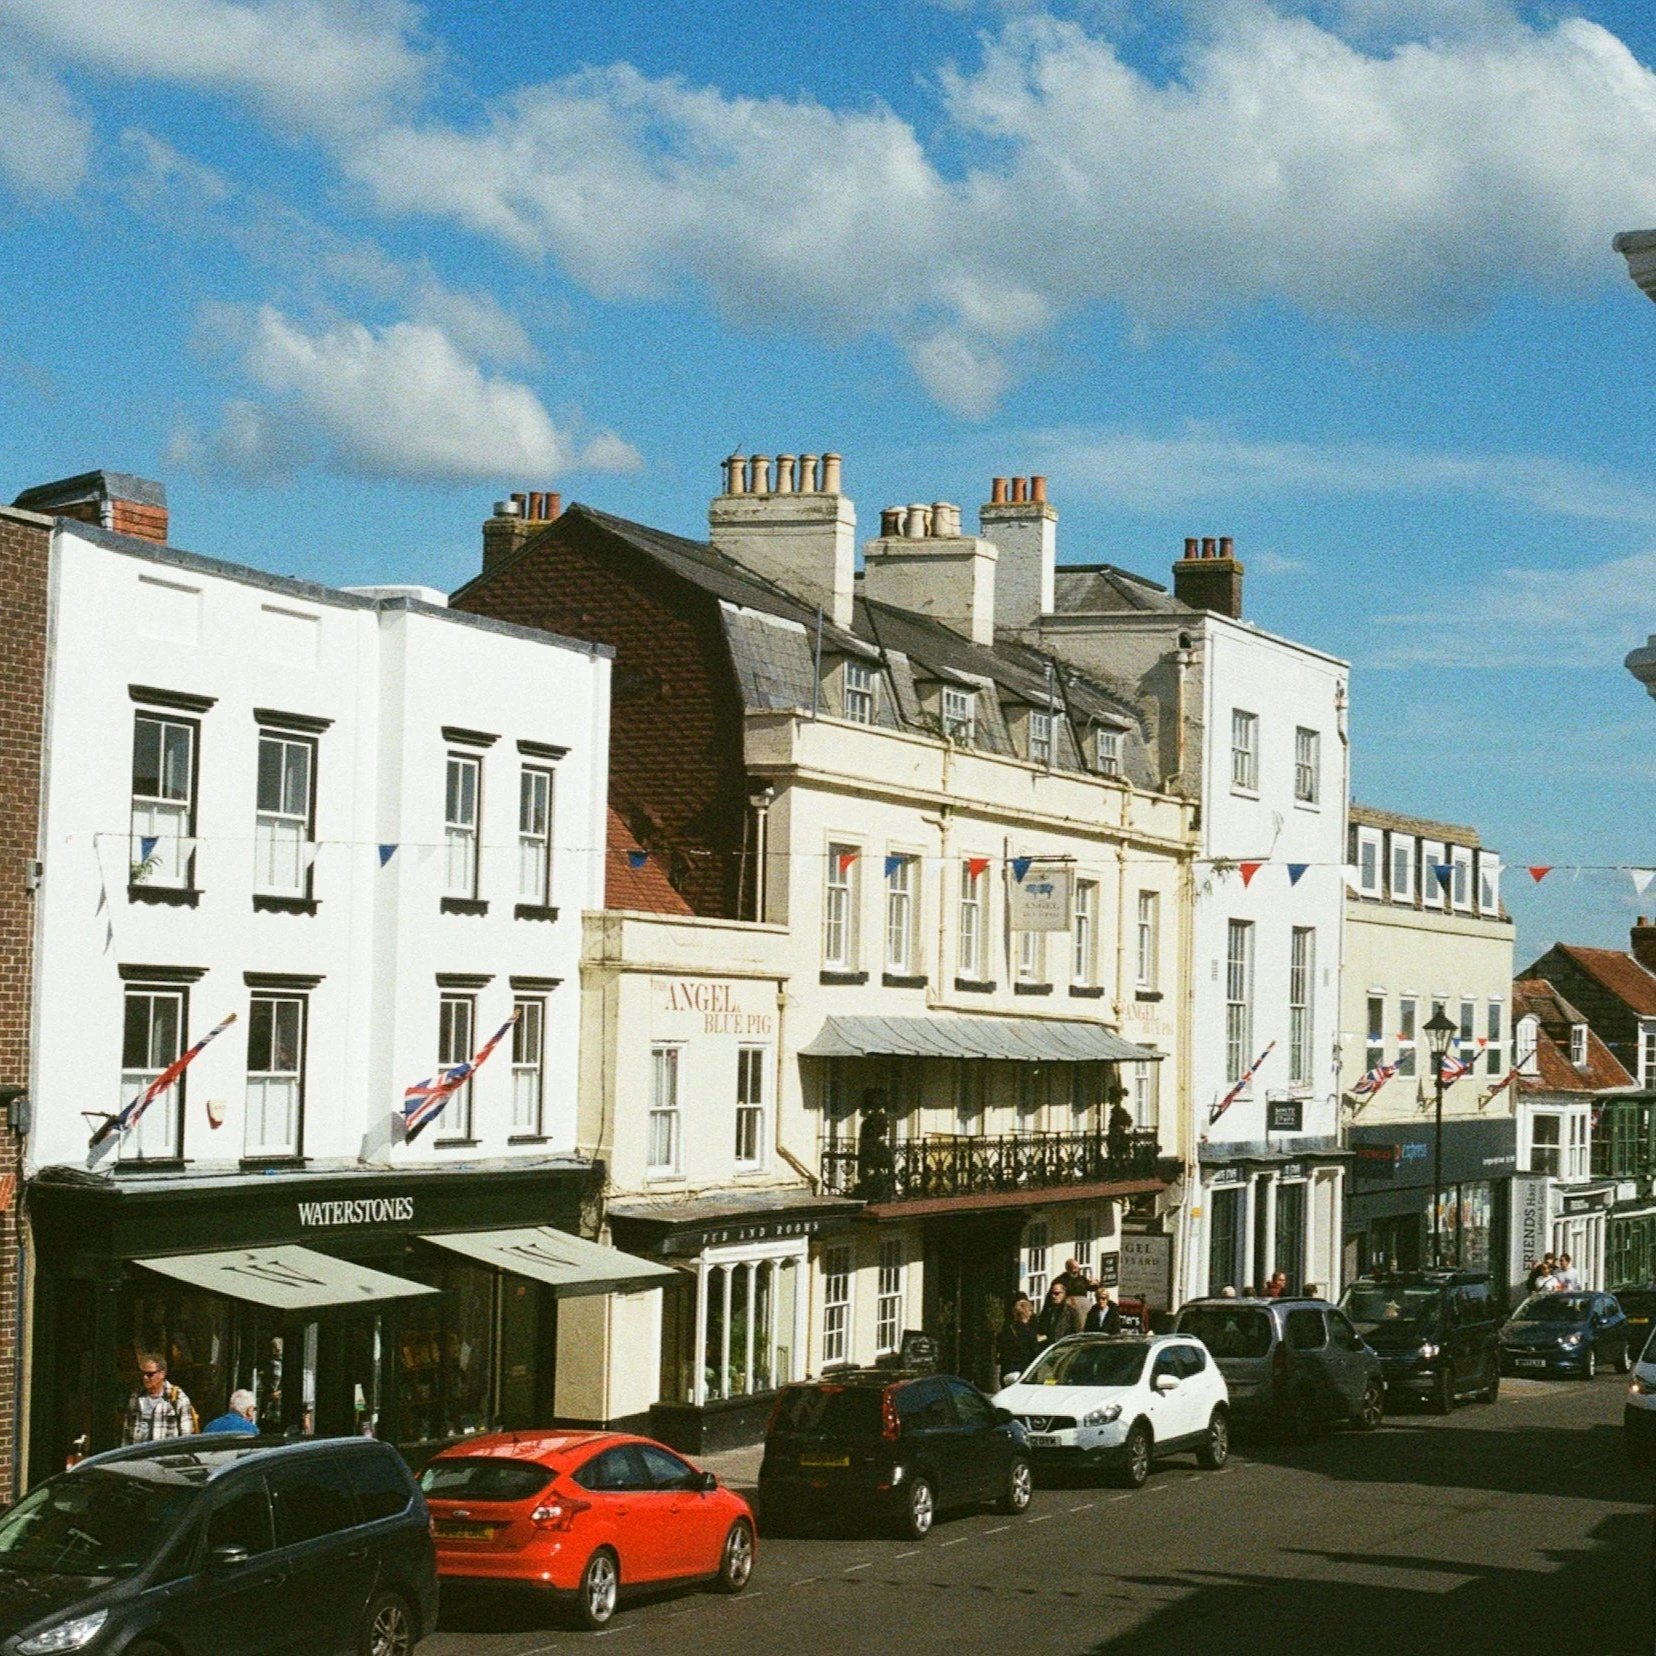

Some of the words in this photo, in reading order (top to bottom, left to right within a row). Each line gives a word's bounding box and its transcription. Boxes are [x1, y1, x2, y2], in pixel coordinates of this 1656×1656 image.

[665, 983, 736, 1012] ANGEL
[704, 1013, 743, 1034] BLUE
[747, 1015, 772, 1035] PIG
[298, 1197, 413, 1226] WATERSTONES
[1523, 1208, 1536, 1272] FRIENDS
